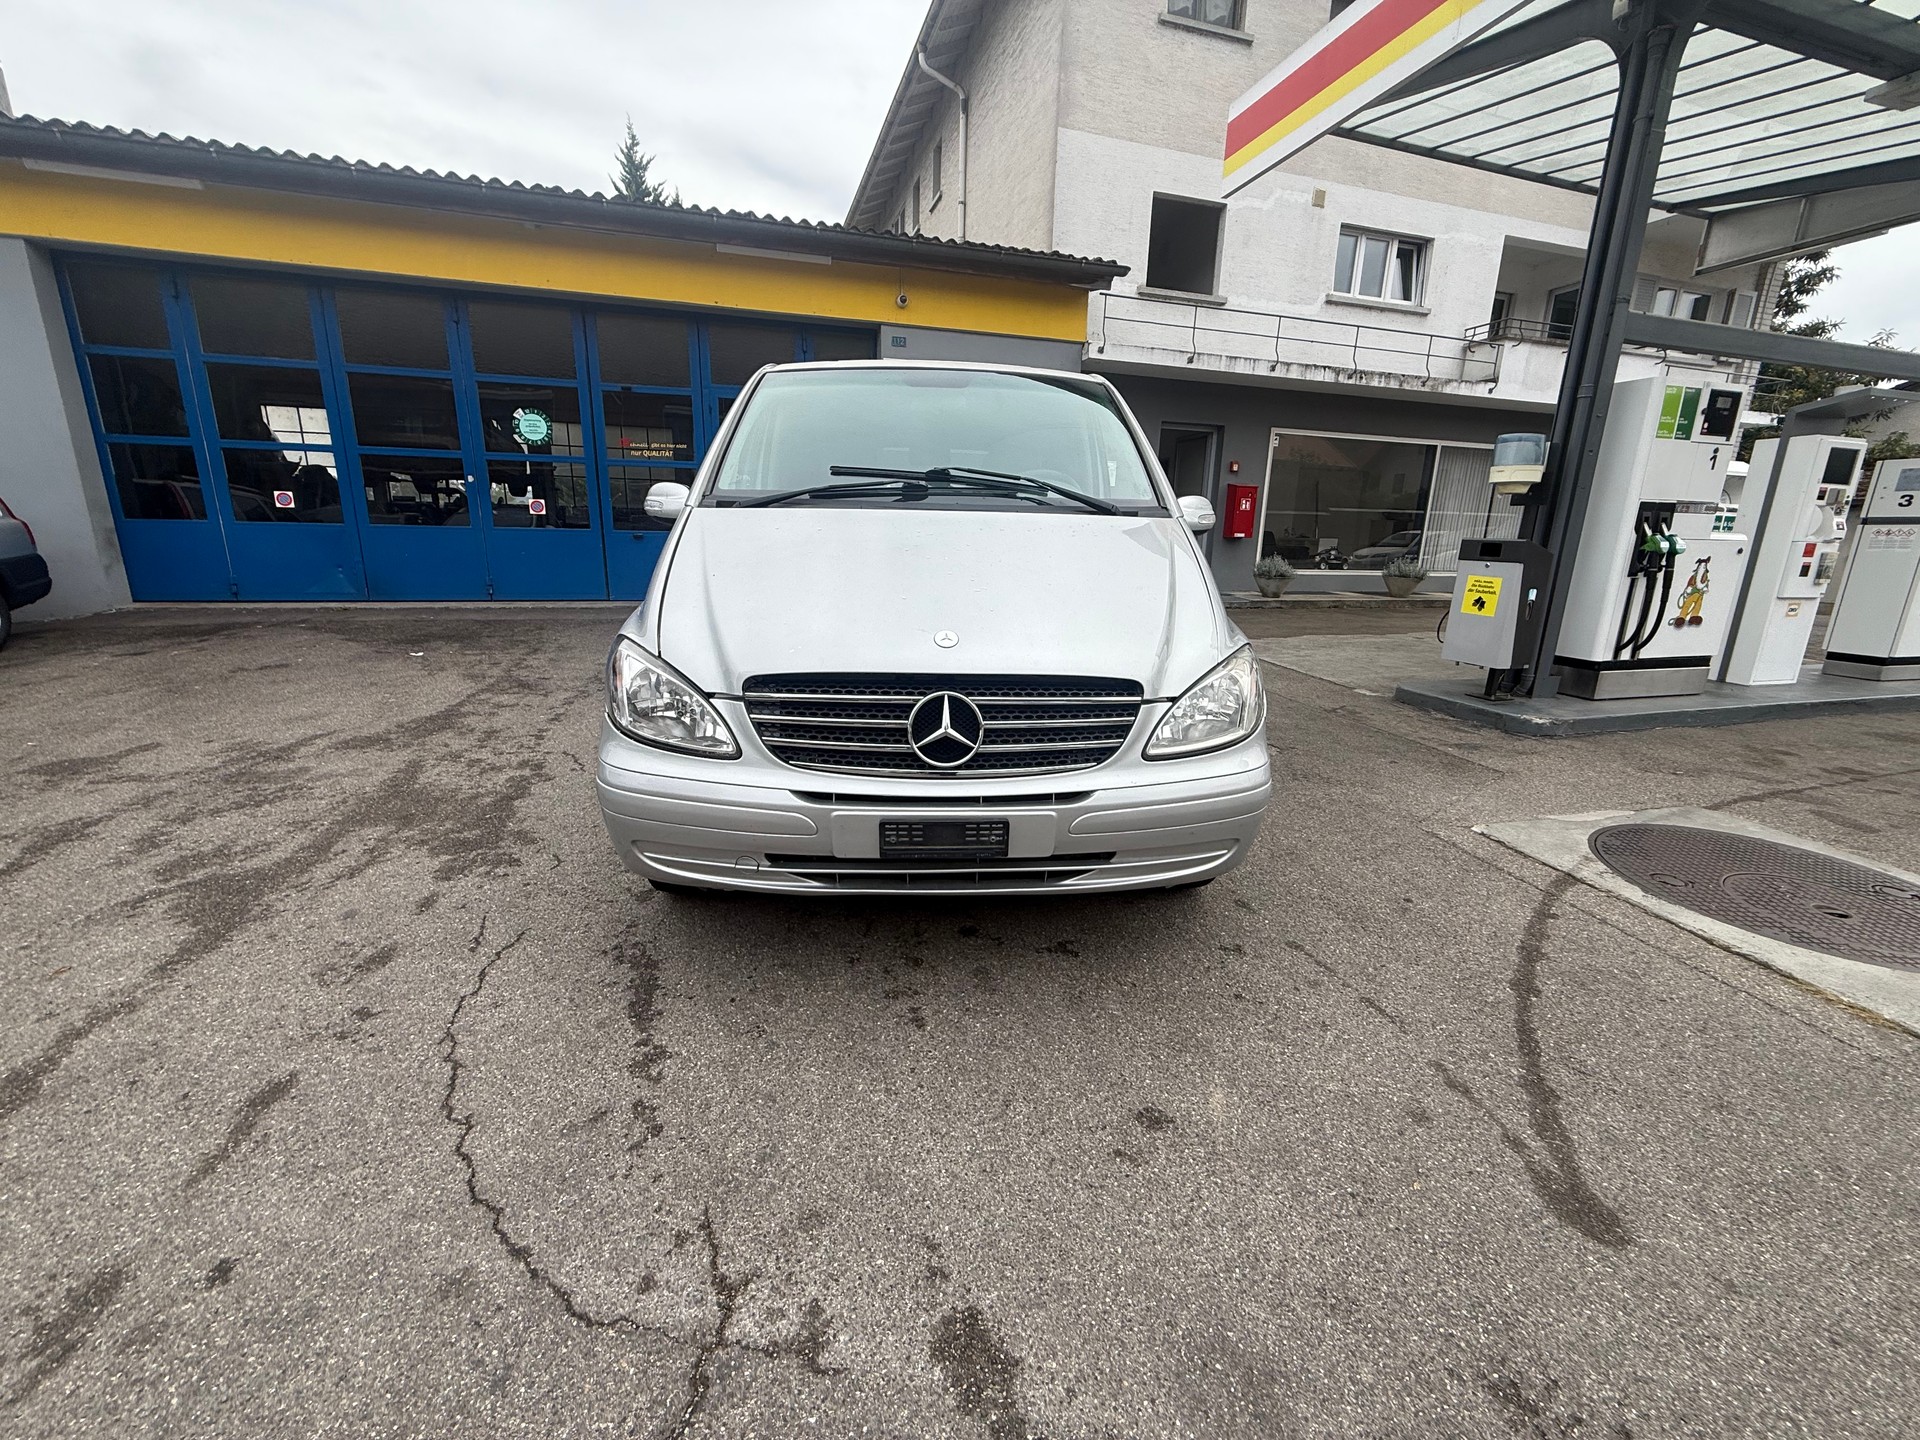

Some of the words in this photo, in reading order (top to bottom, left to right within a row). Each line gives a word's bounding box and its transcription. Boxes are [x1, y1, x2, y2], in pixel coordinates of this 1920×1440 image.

[642, 449, 673, 457] QUALITÄT
[1709, 454, 1718, 470] 1
[1897, 494, 1914, 508] 3
